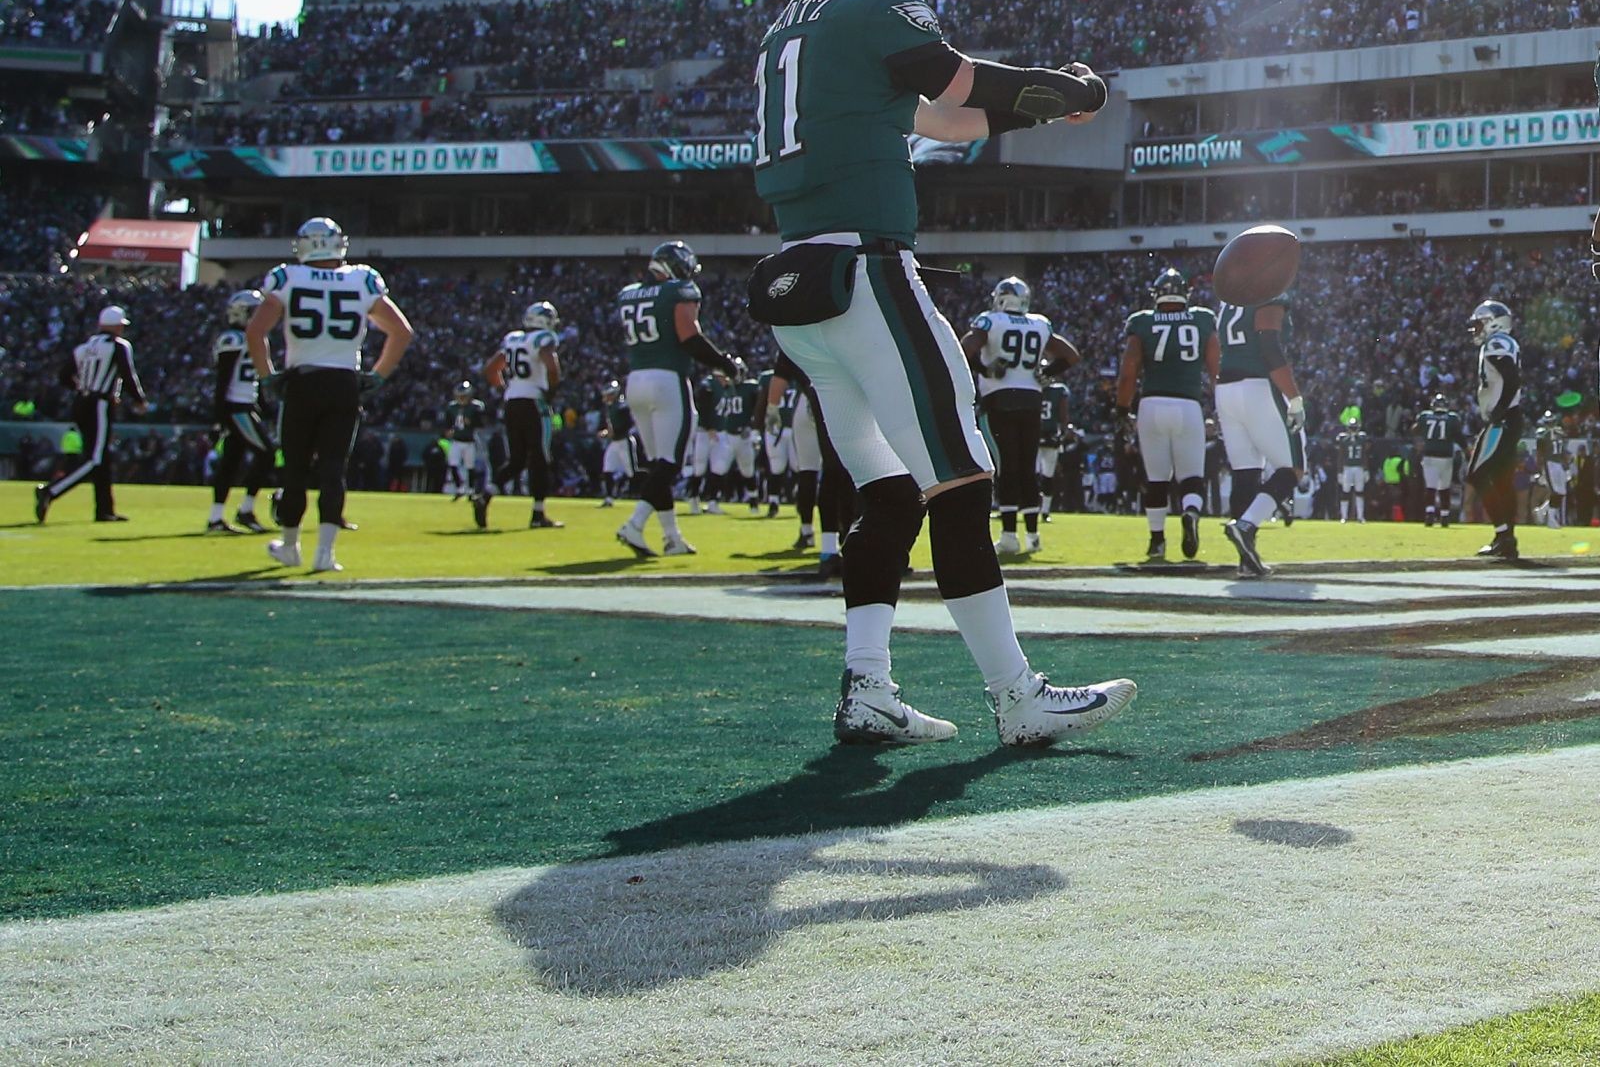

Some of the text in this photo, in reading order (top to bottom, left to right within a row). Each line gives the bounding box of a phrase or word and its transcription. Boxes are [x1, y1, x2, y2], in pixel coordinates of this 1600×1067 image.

[753, 37, 803, 166] 11
[313, 146, 499, 172] TOUCHDOWN
[290, 287, 361, 340] 55
[1002, 329, 1042, 369] 99
[1152, 324, 1200, 362] 79
[1426, 420, 1447, 440] 71
